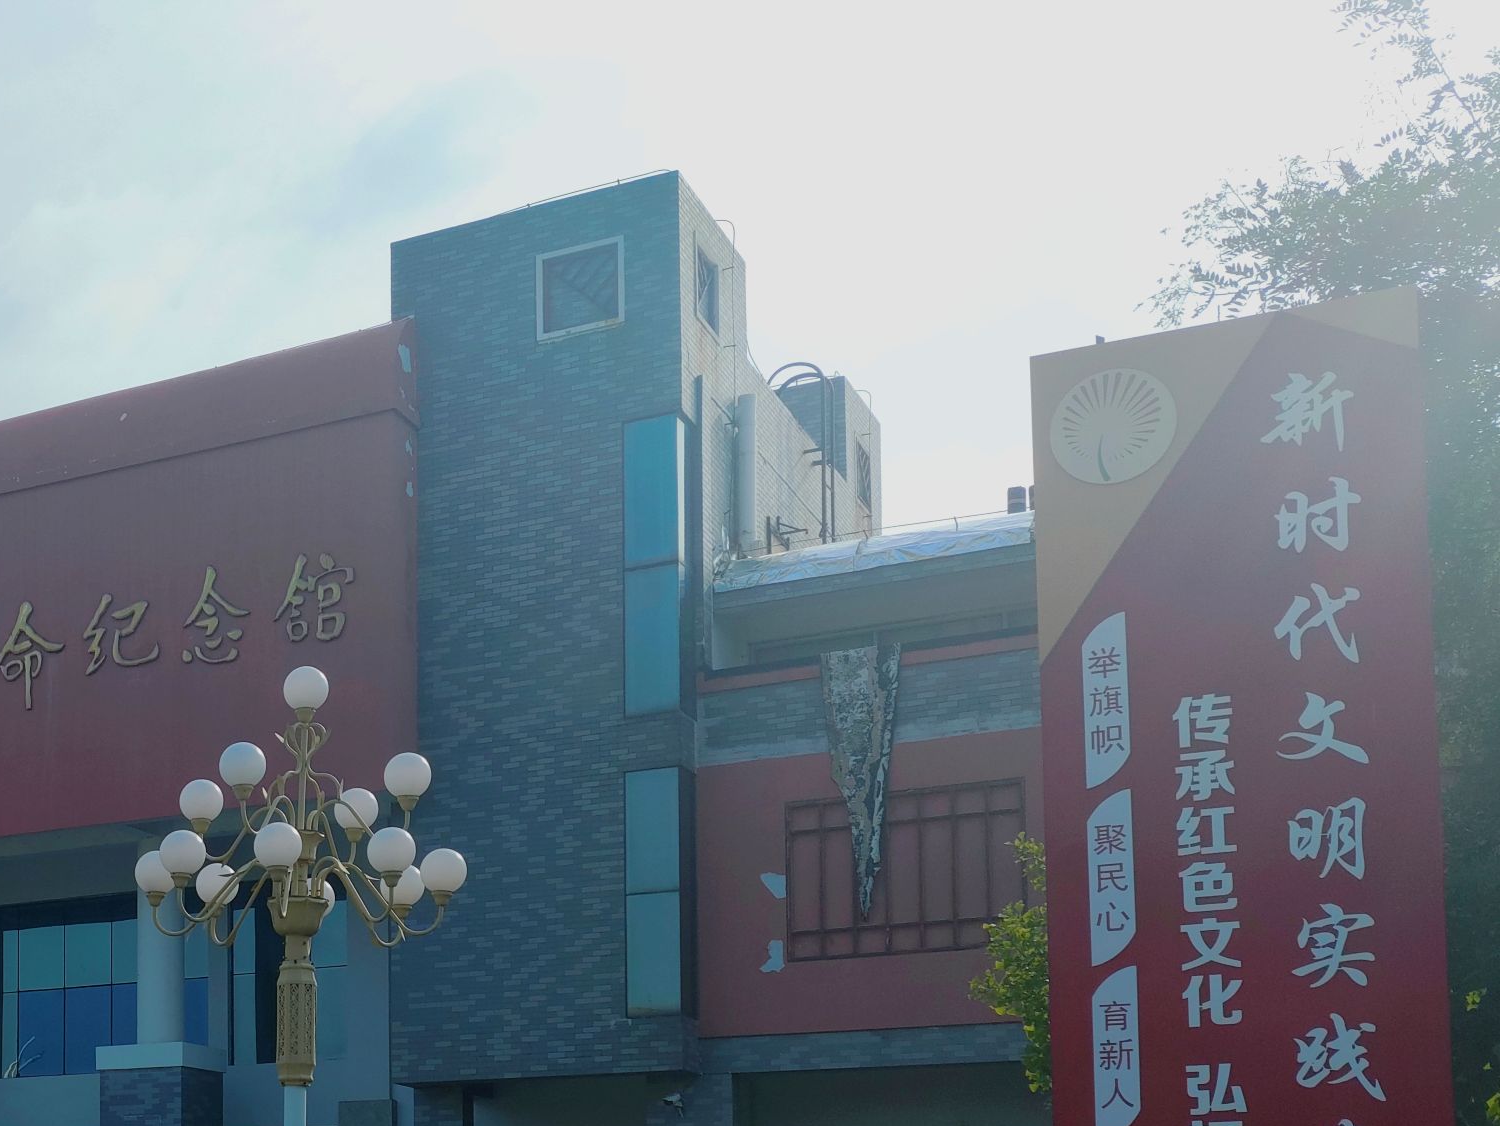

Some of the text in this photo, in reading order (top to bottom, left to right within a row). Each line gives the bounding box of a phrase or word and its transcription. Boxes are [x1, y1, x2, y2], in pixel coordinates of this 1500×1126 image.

[1088, 646, 1125, 755] 举旗帜
[1093, 824, 1130, 932] 聚民心
[1172, 693, 1244, 1029] 传承红色文化
[1099, 1001, 1135, 1110] 育新人
